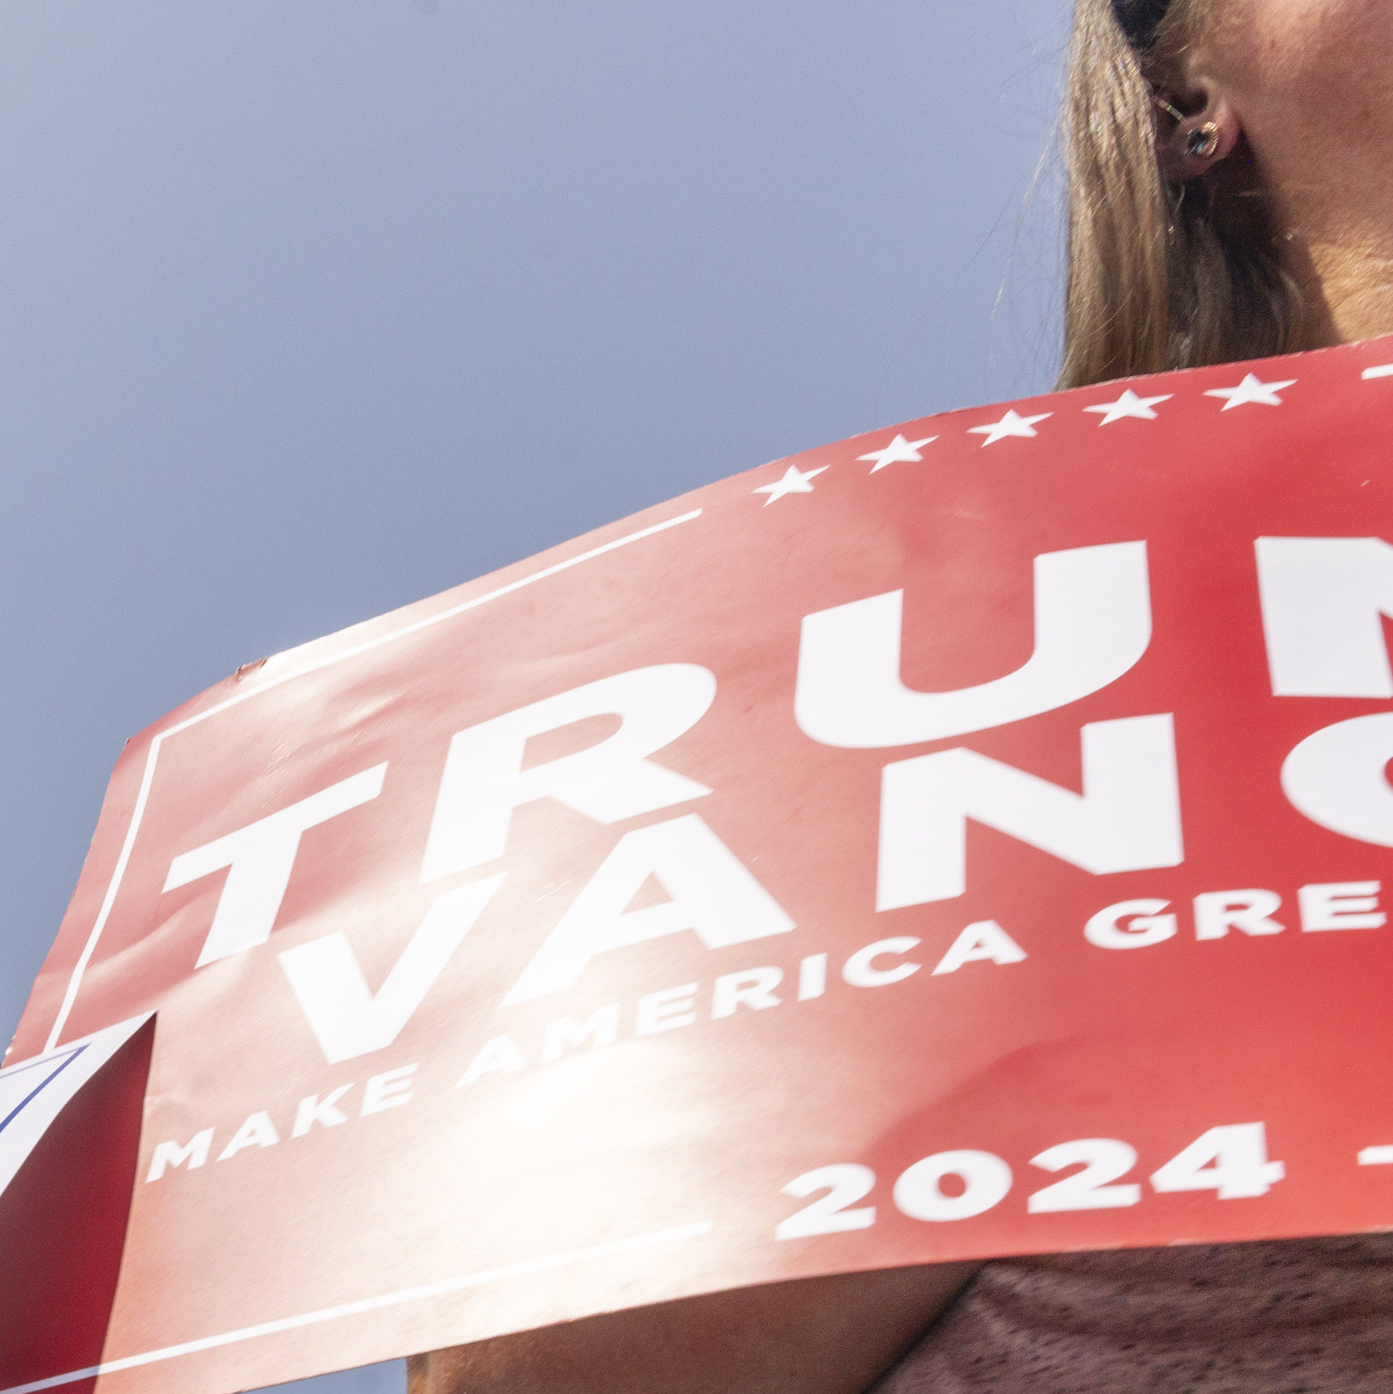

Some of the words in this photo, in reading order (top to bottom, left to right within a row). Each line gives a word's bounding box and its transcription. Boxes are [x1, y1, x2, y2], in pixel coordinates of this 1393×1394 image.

[162, 535, 1393, 969] TRU
[145, 1062, 419, 1184] MAKE
[454, 919, 1028, 1089] AMERICA
[774, 1120, 1286, 1242] 2024
